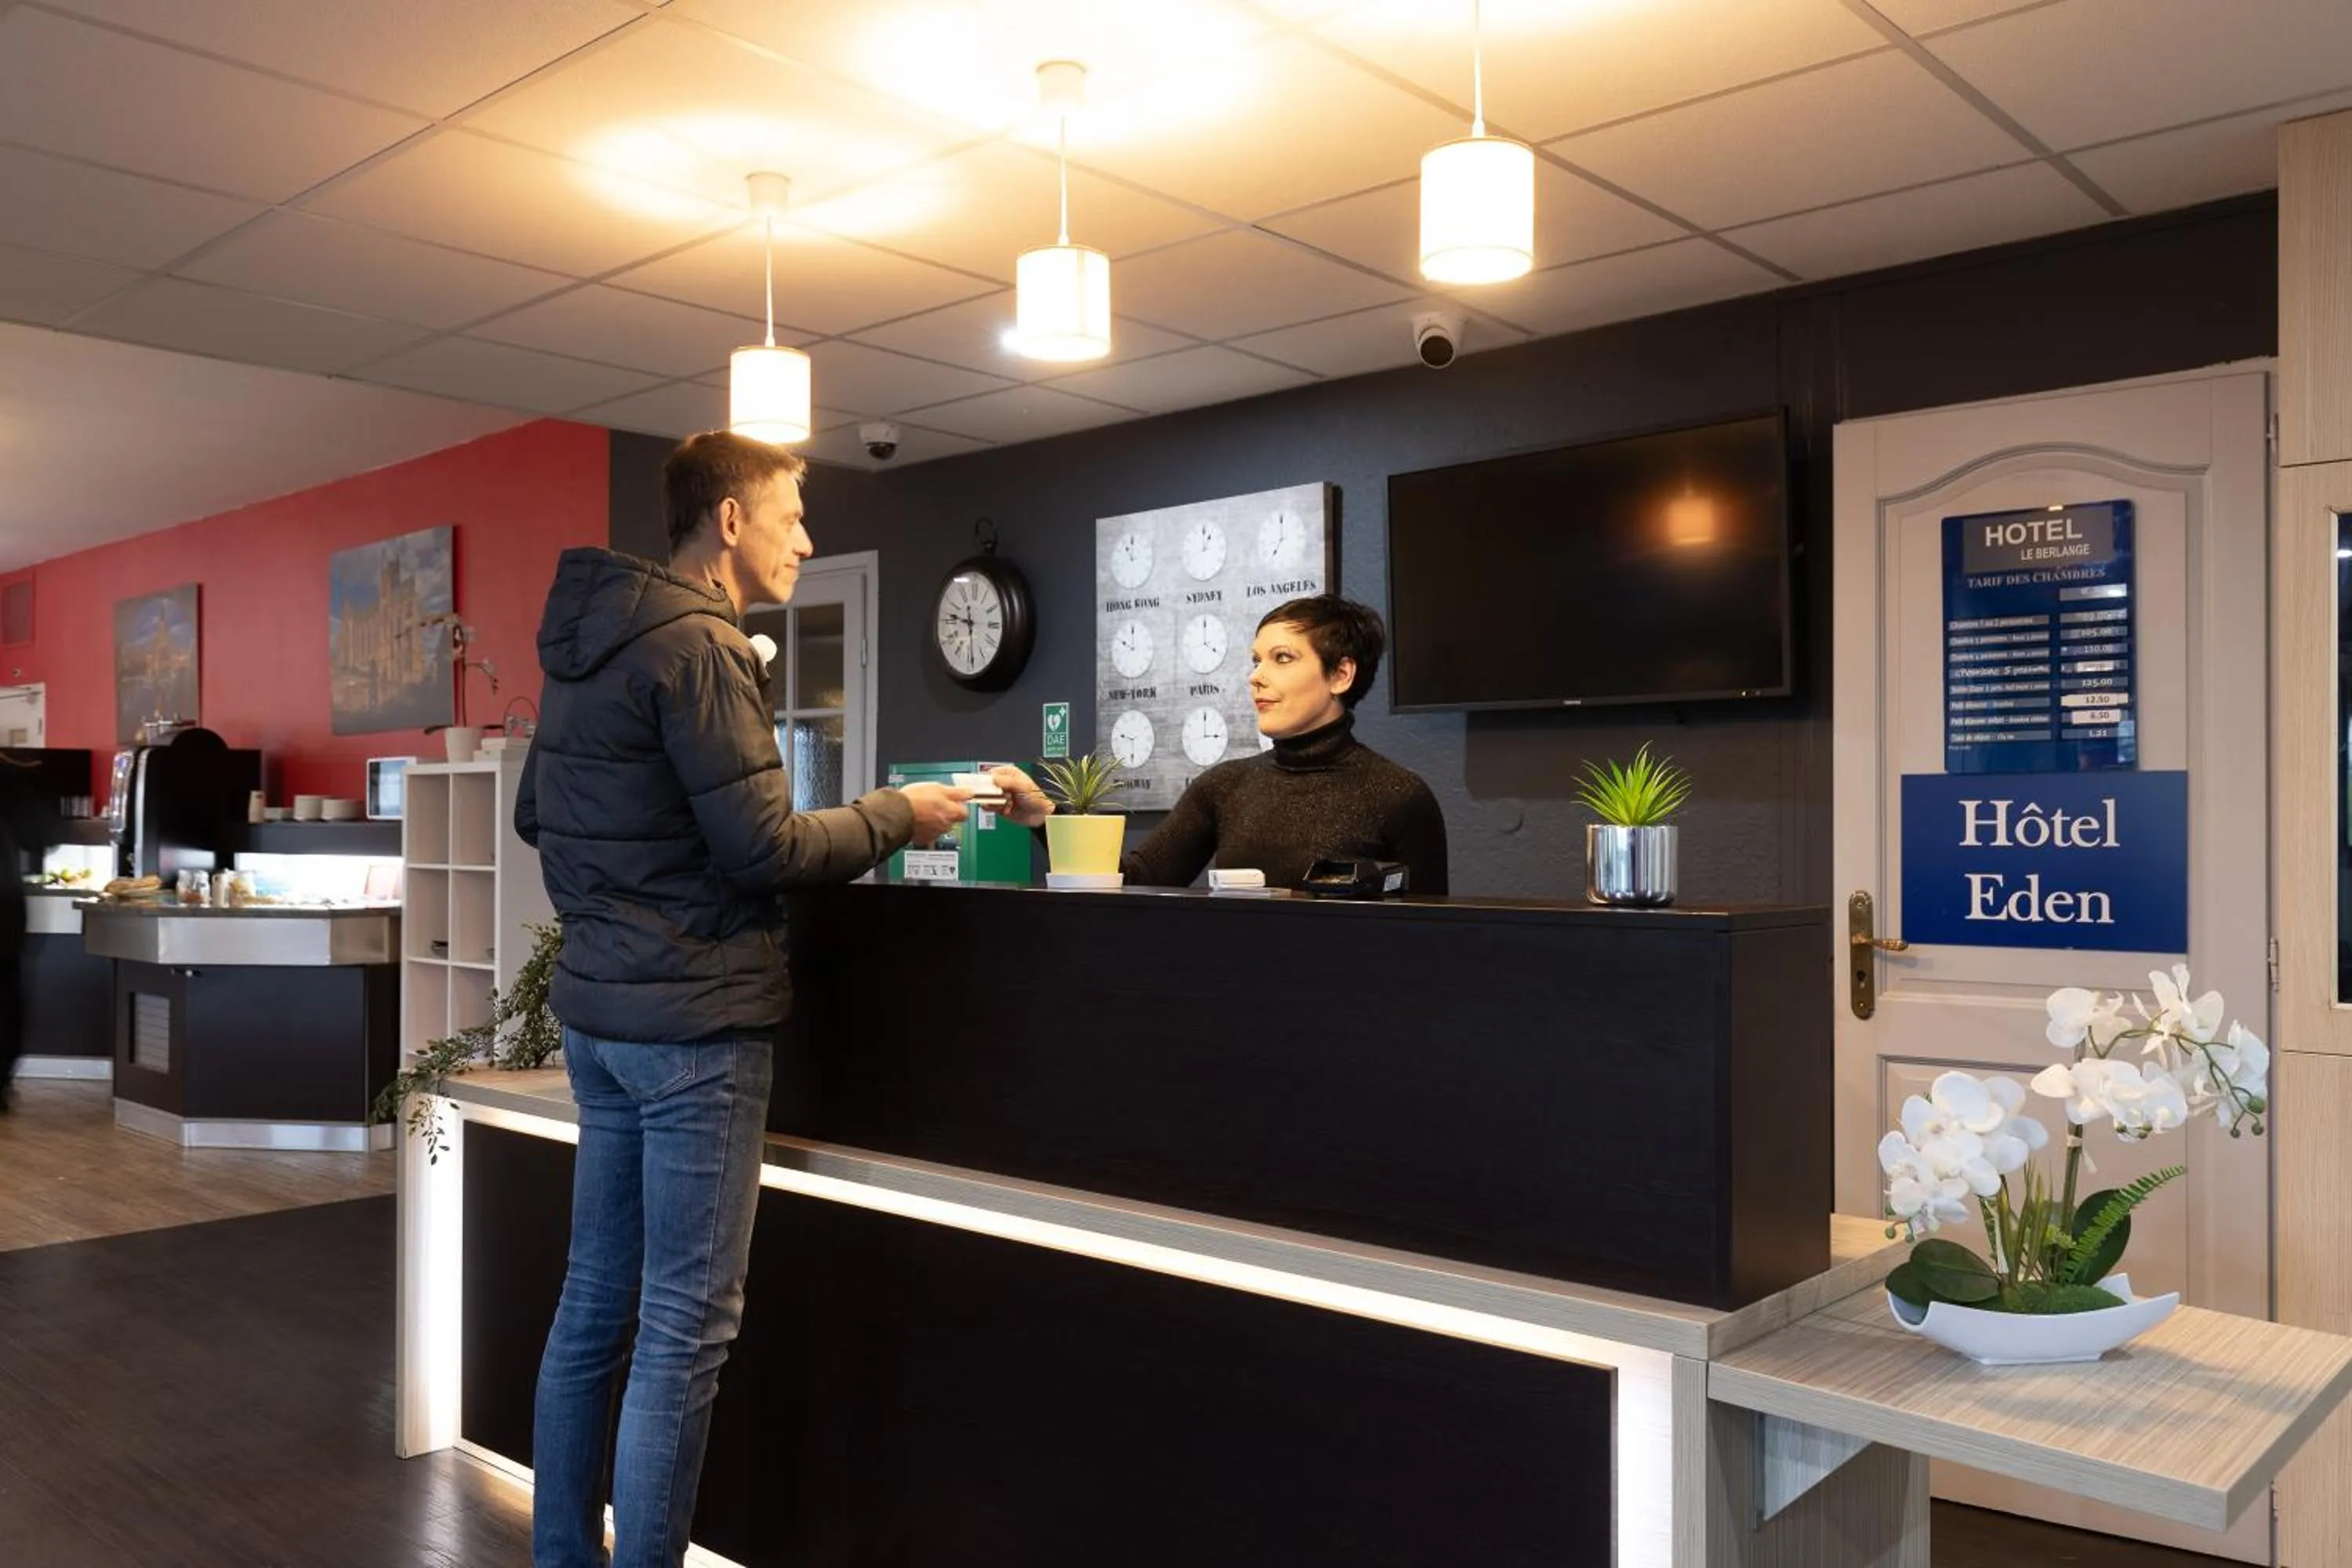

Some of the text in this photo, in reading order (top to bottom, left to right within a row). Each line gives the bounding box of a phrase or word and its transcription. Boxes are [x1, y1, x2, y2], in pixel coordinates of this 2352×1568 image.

[1985, 518, 2083, 546] HOTEL
[2021, 543, 2090, 561] LE BERLANGE
[1968, 568, 2106, 589] TARIF DES CHAMBRES
[1185, 590, 1222, 604] SYDNEY
[1247, 579, 1316, 597] LOS ANGELES
[1106, 597, 1160, 612] HONG KONG
[1189, 684, 1219, 696] PARIS
[1958, 798, 2121, 848] Hôtel
[1964, 873, 2115, 924] Eden
